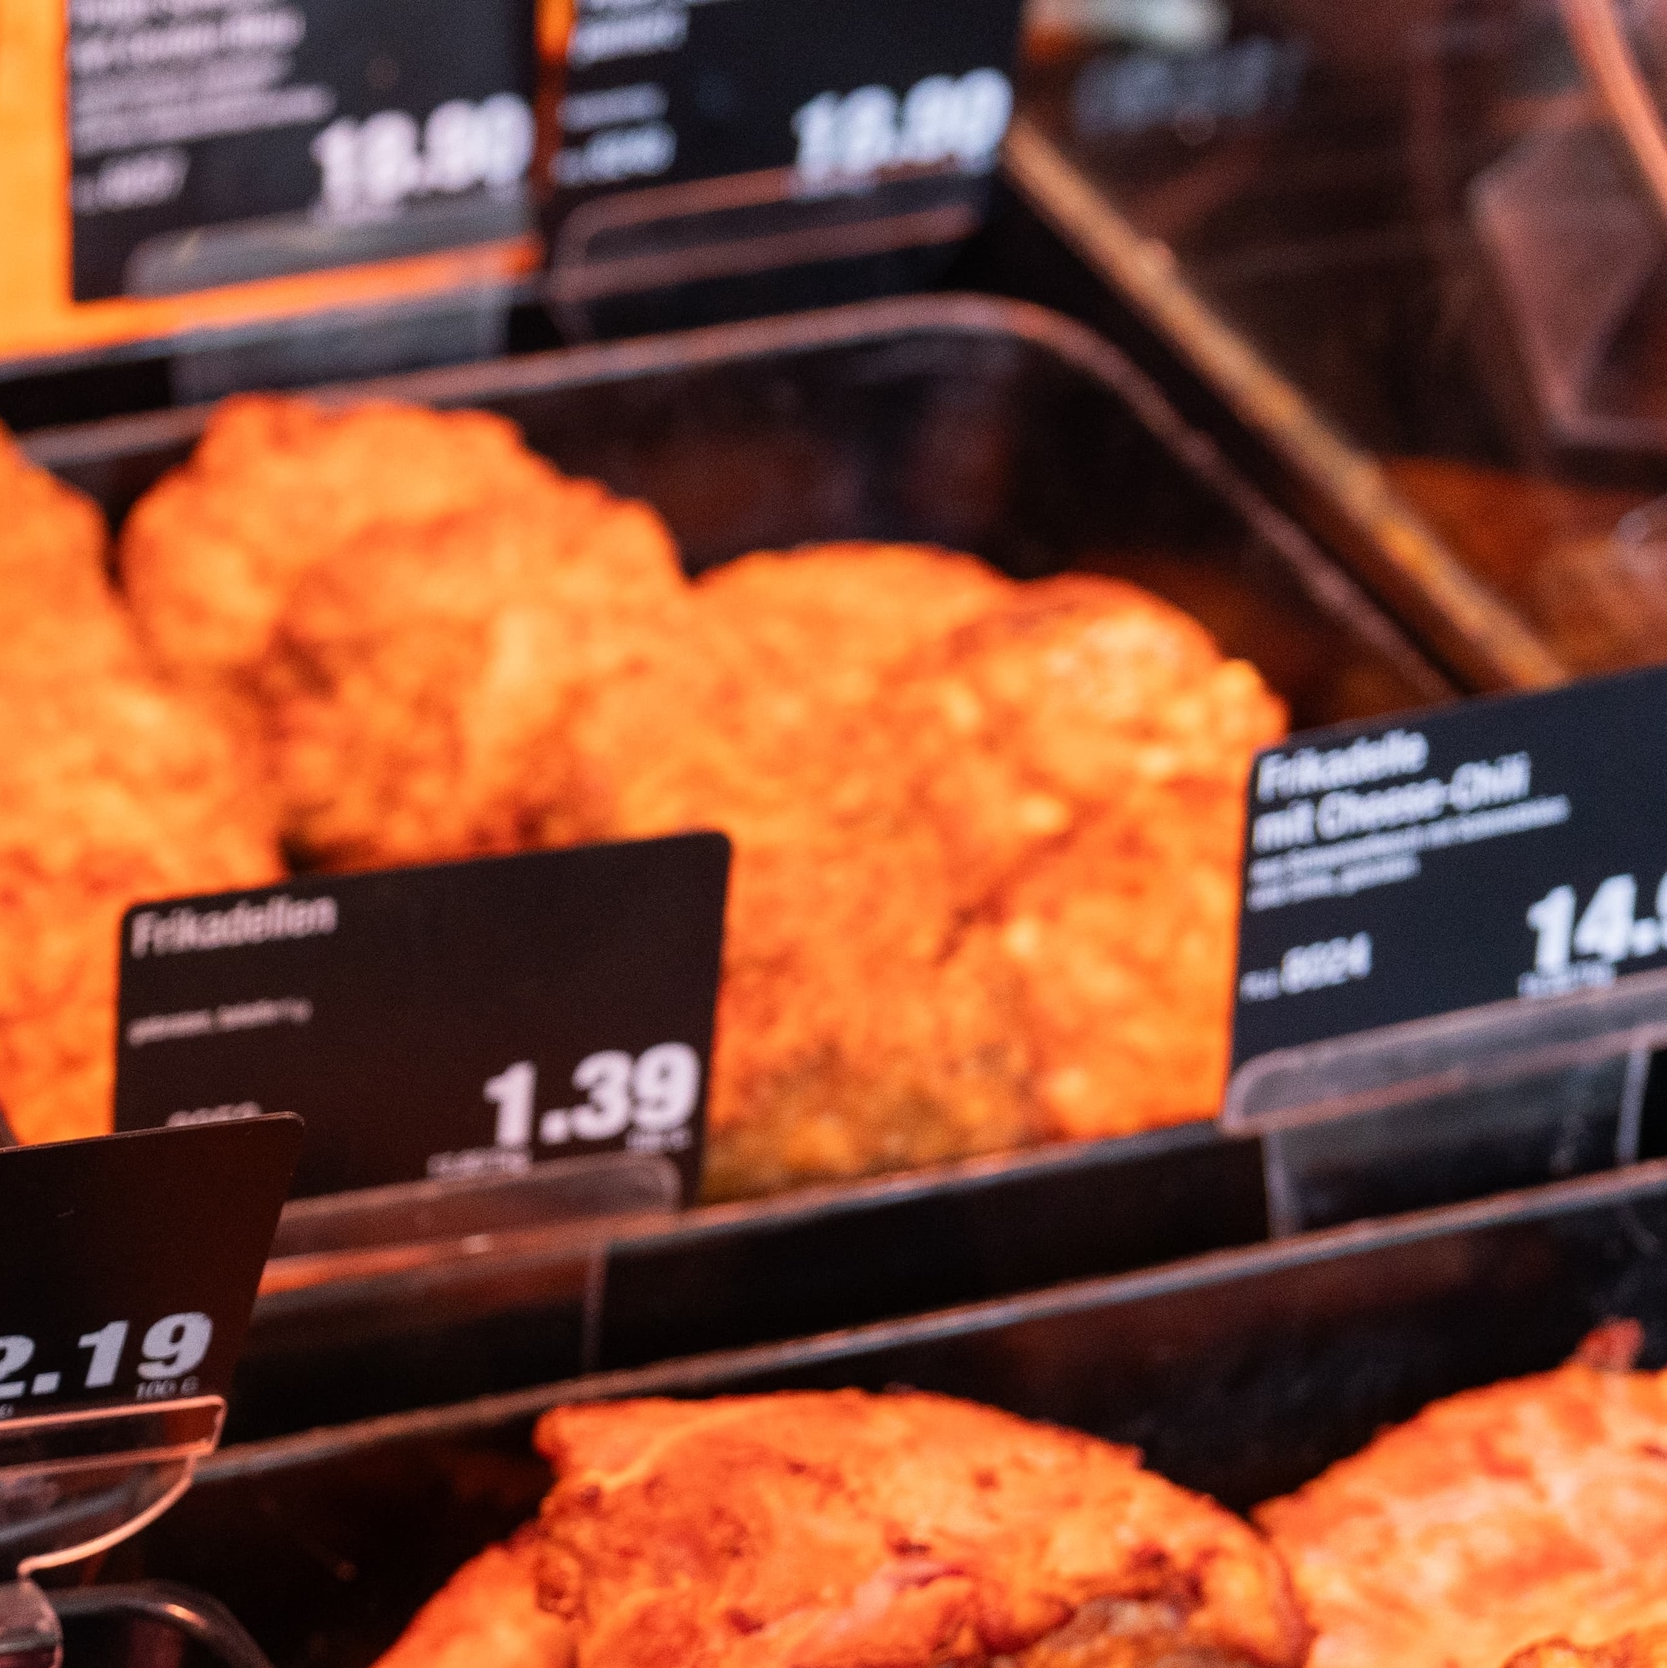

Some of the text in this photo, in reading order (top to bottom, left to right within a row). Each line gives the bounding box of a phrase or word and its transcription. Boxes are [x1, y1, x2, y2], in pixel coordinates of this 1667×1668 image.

[1257, 729, 1429, 801] Frikadelle
[1252, 799, 1316, 852] mit
[131, 895, 338, 958] Frikadellen
[483, 1041, 701, 1148] 1.39
